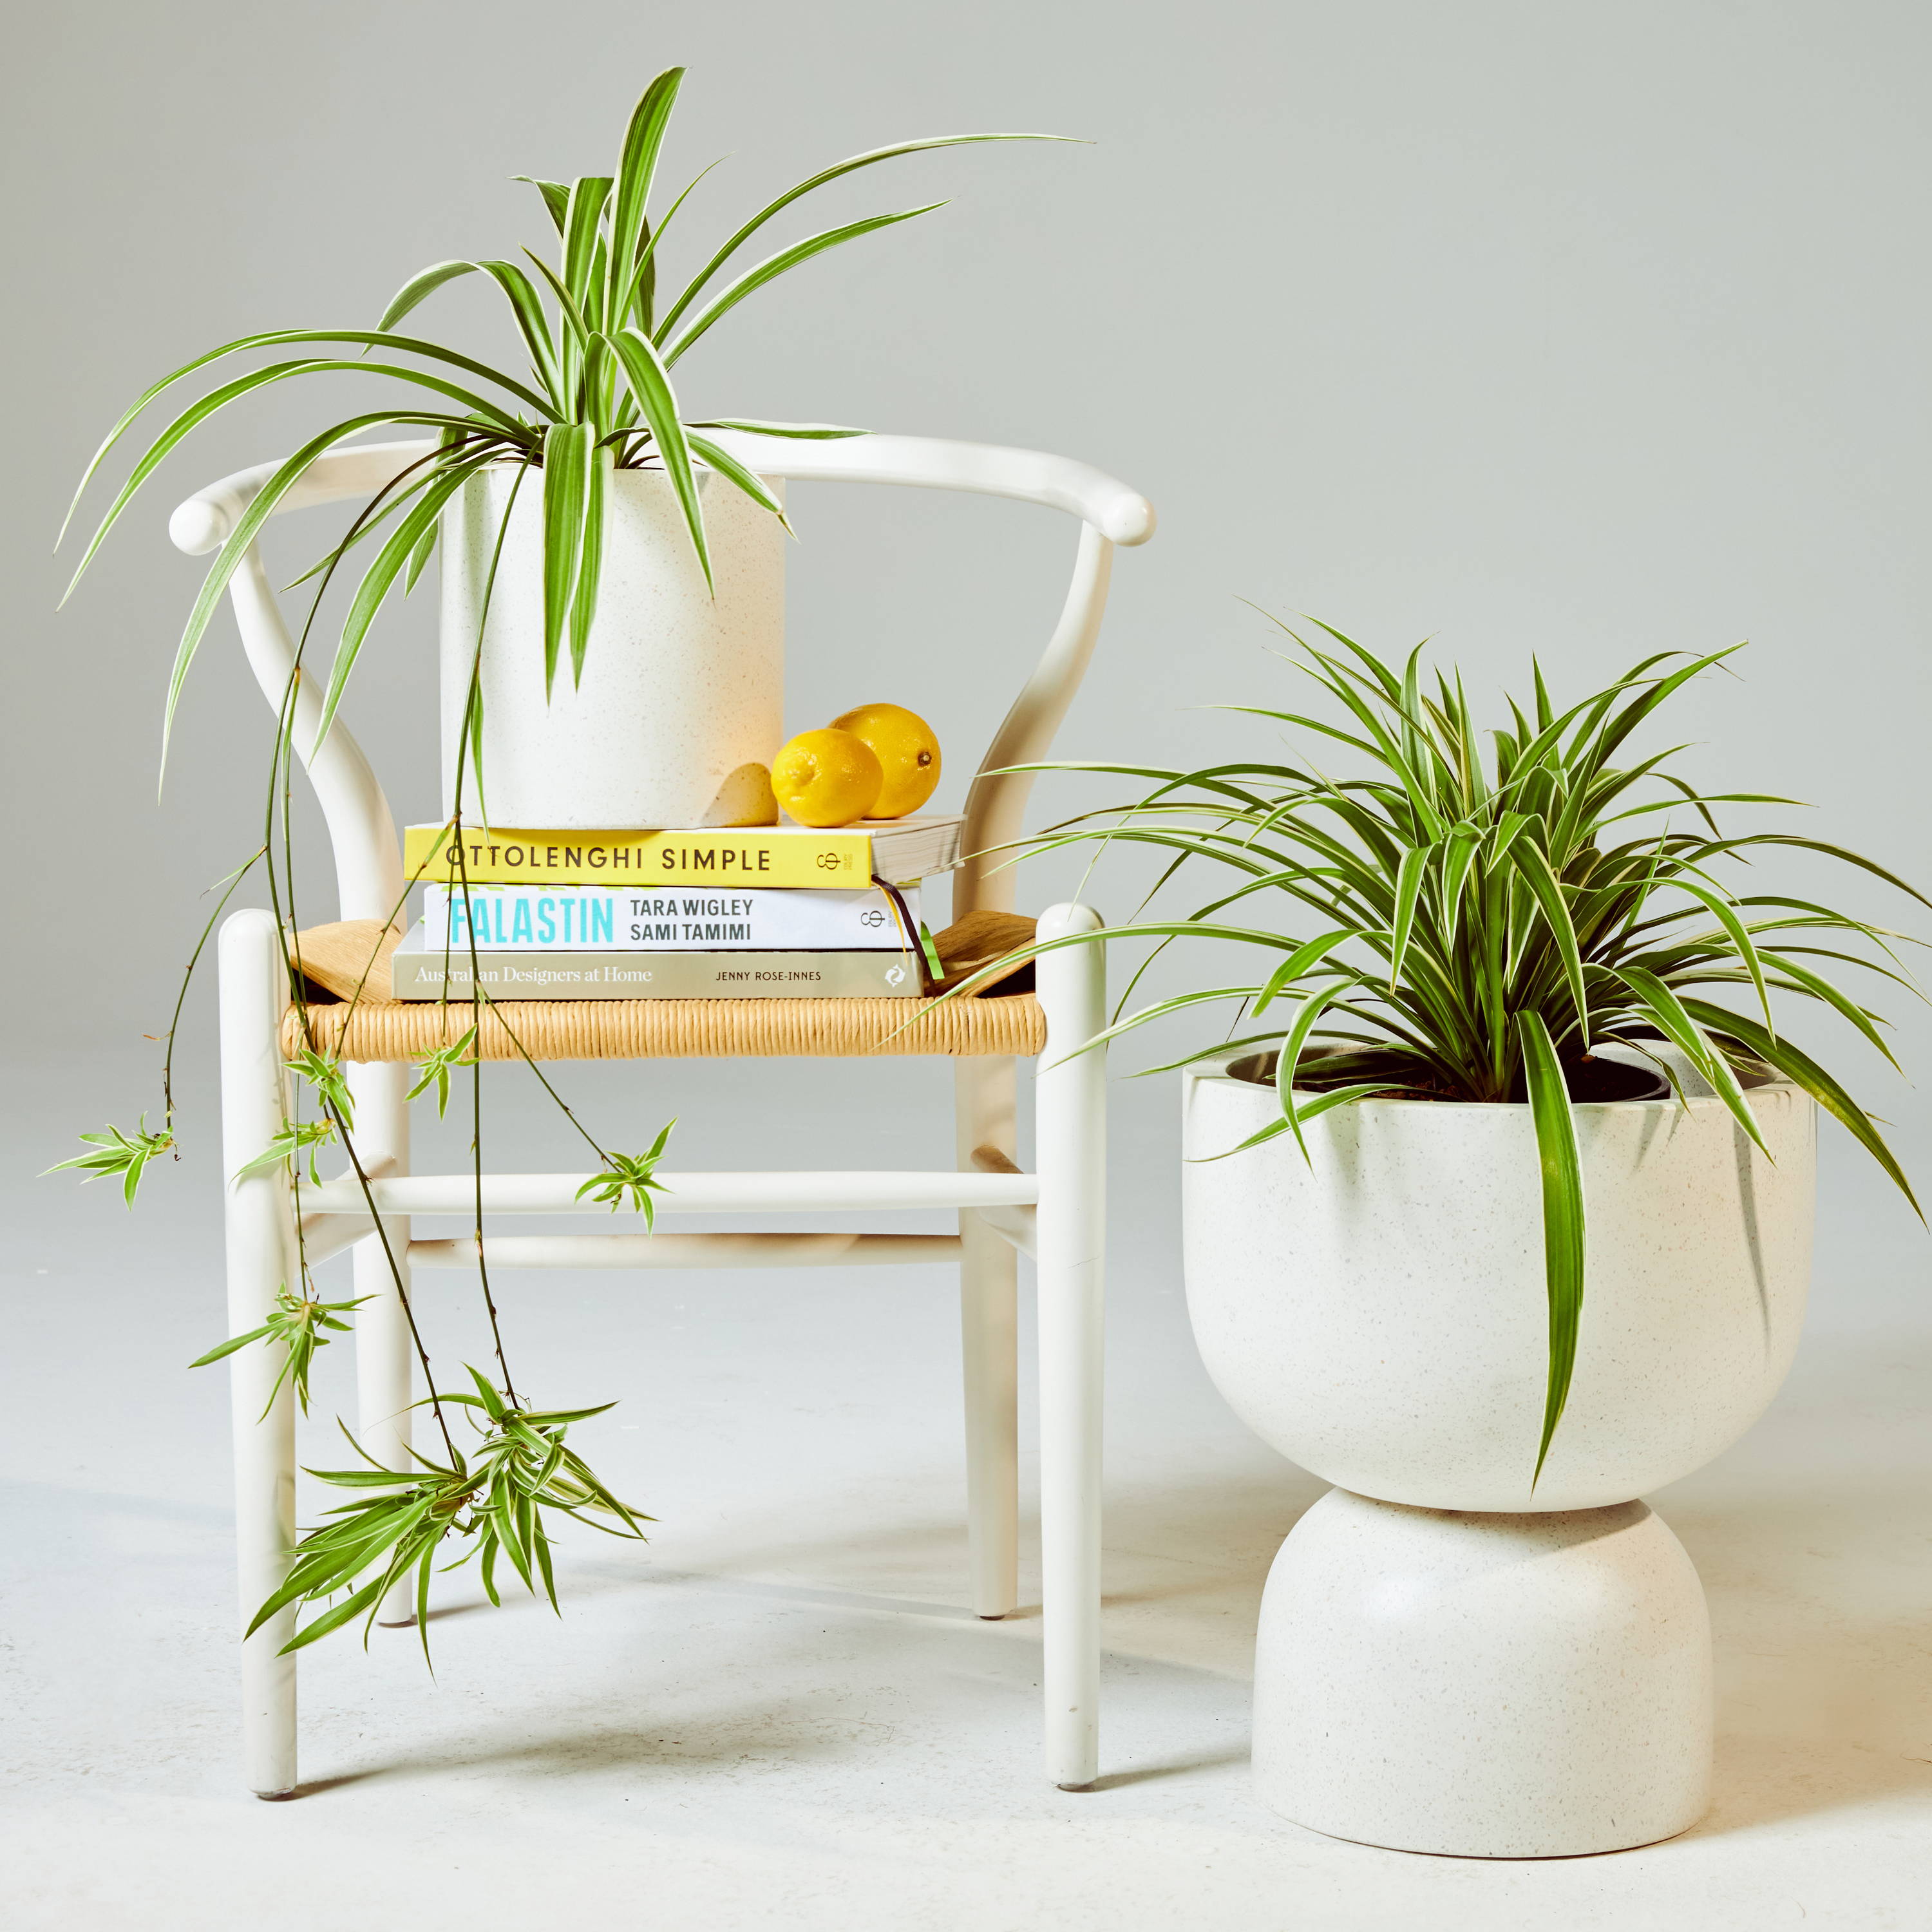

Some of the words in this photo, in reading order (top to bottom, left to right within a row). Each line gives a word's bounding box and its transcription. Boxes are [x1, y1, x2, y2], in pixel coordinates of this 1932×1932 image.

[446, 845, 641, 869] OTTOLENGHI
[661, 848, 770, 871] SIMPLE
[630, 899, 678, 916] TARA
[682, 899, 753, 916] WIGLEY
[450, 898, 613, 943] FALASTIN
[630, 923, 677, 941] SAMI
[681, 923, 750, 940] TAMIMI
[415, 966, 498, 982] Australan
[503, 966, 581, 985] Designers
[584, 968, 600, 982] at
[603, 966, 652, 982] Home
[715, 971, 750, 981] JENNY
[755, 971, 821, 981] ROSE-INNES
